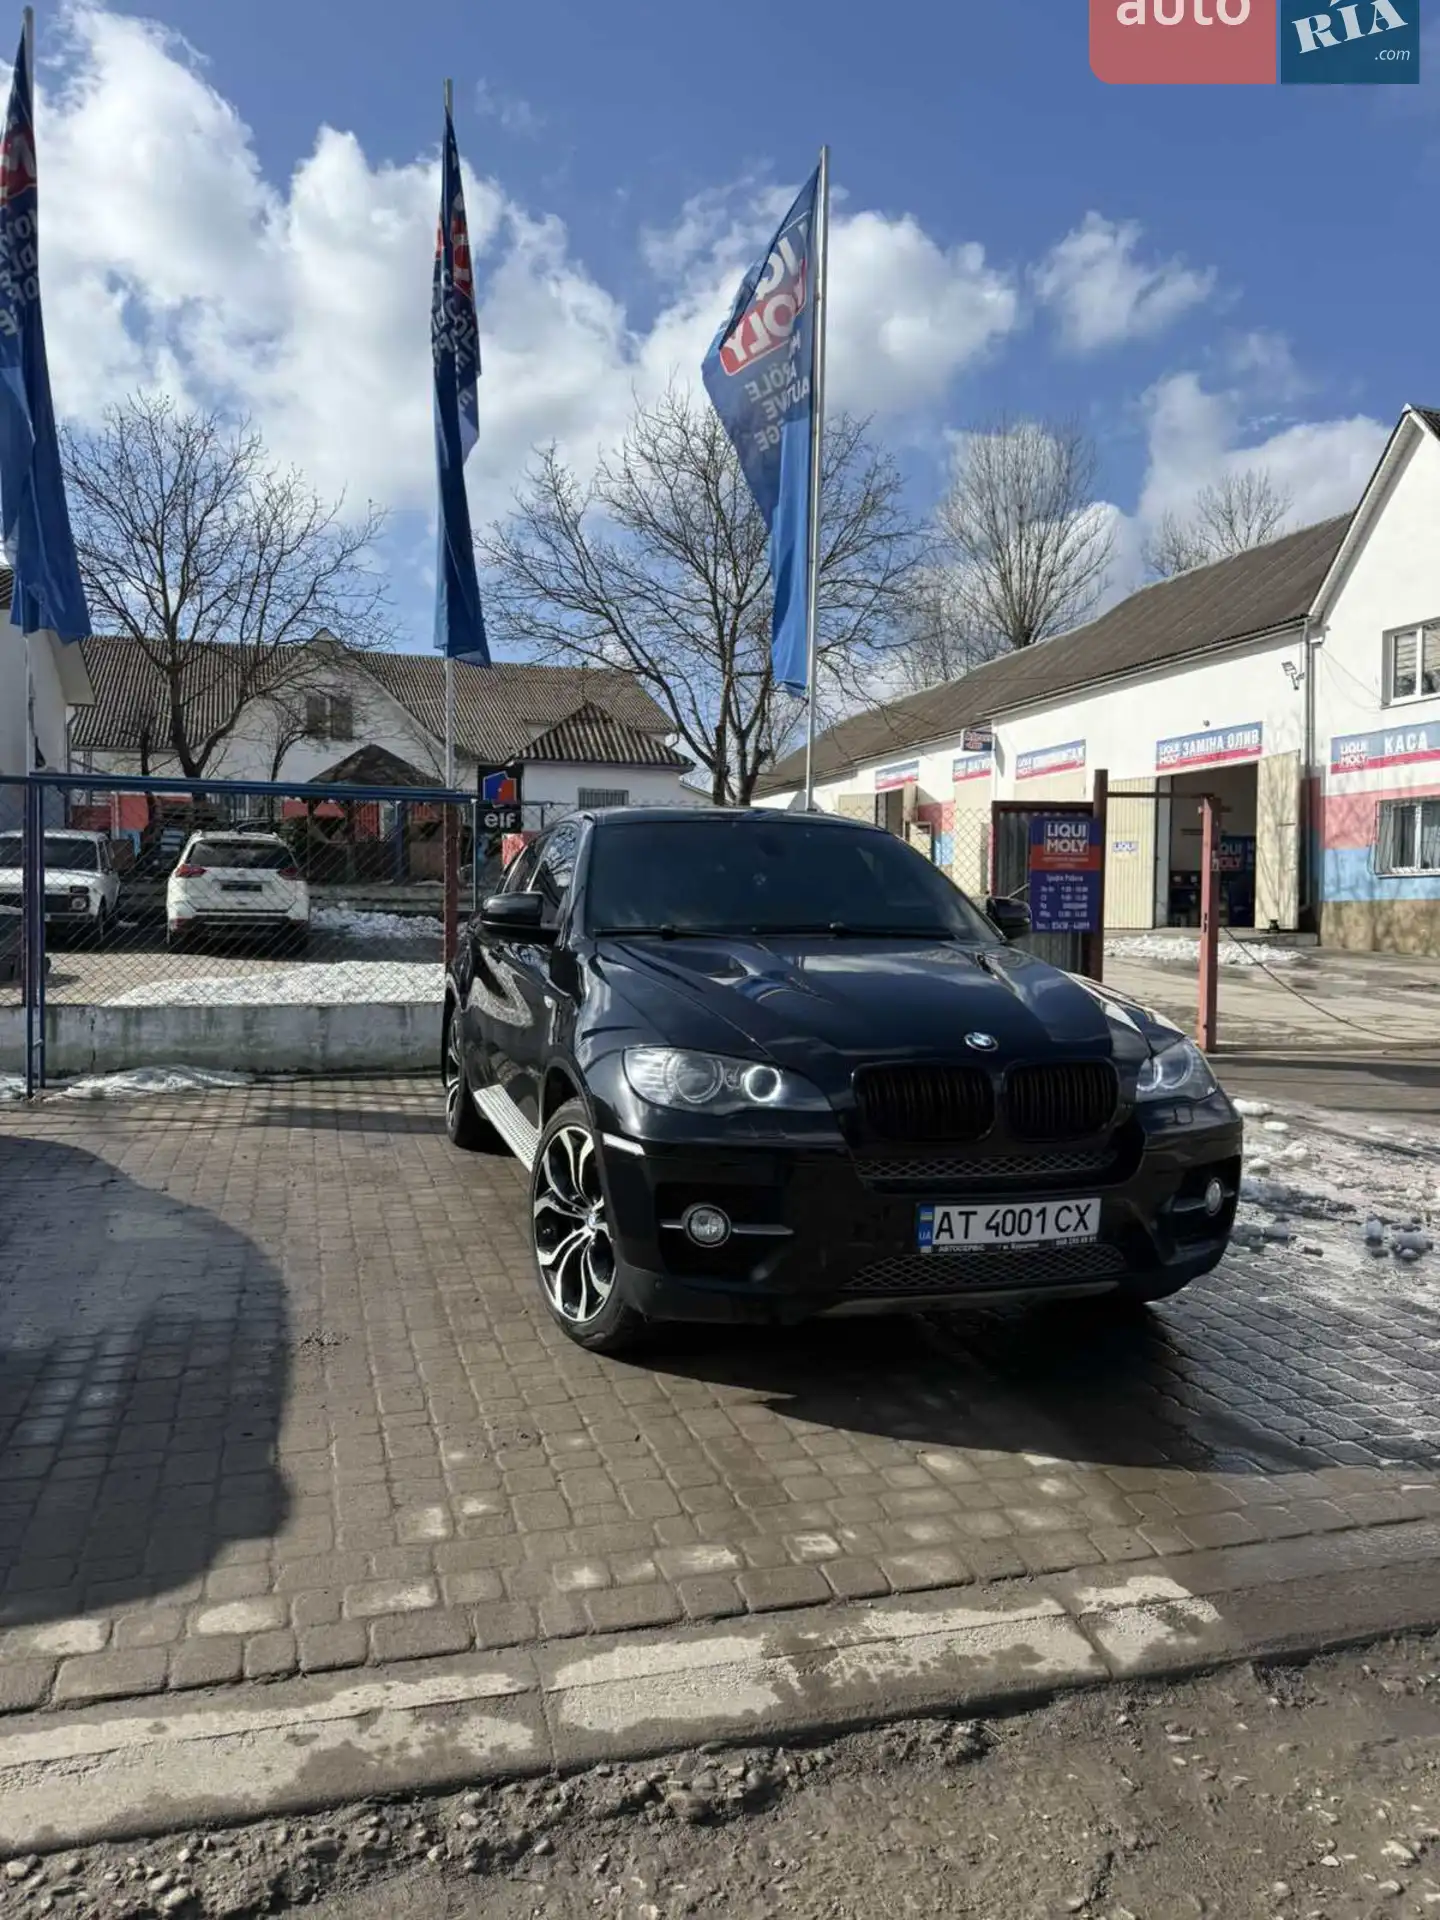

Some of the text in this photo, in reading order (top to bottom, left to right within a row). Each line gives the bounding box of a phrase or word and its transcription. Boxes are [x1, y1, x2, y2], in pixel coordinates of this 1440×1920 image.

[1384, 730, 1428, 755] КАСА
[484, 813, 516, 828] elf
[1047, 824, 1087, 837] LIQUI
[1046, 839, 1088, 852] MOLY
[935, 1203, 1091, 1240] AT 4001 CX
